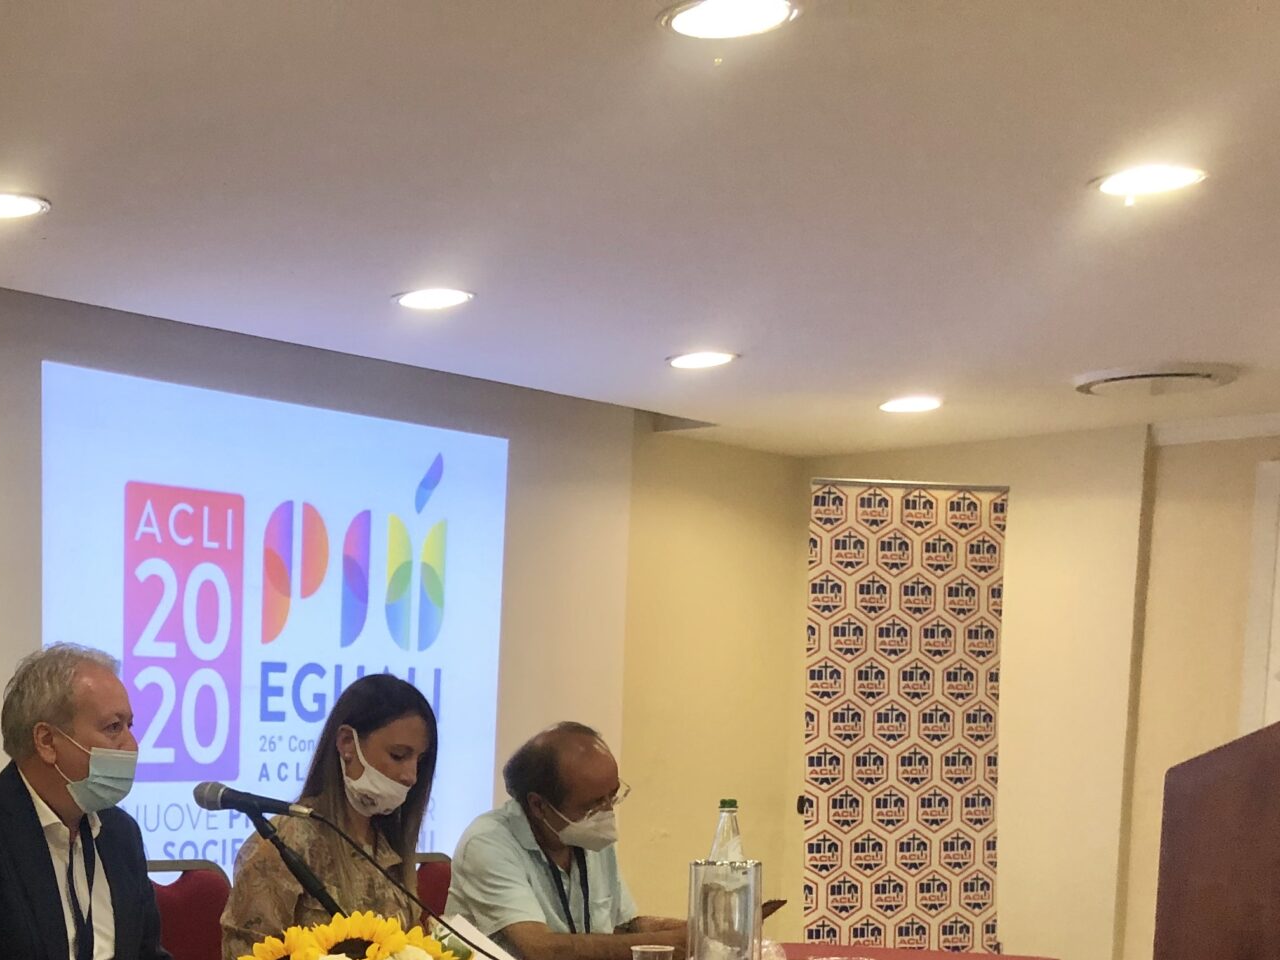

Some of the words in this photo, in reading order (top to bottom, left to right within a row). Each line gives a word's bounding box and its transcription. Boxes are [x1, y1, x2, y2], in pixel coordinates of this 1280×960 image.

[134, 499, 234, 552] ACLI
[132, 557, 232, 662] 20
[132, 665, 231, 766] 20
